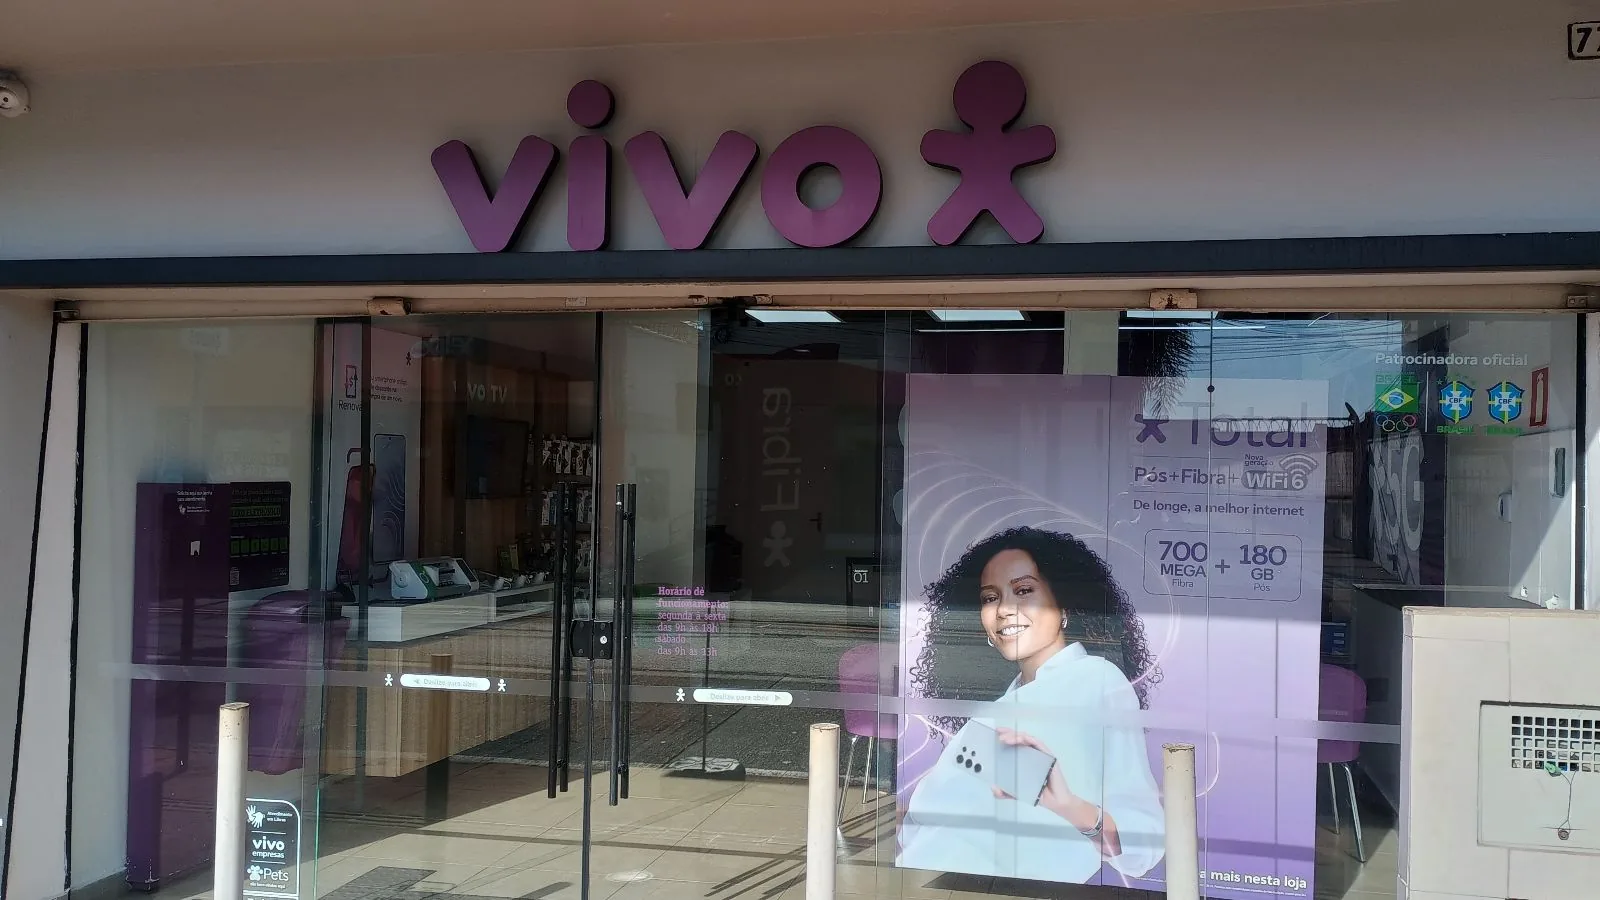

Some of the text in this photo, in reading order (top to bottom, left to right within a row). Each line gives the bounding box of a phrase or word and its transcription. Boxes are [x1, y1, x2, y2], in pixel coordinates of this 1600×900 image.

[1576, 27, 1600, 53] 7
[431, 80, 883, 253] vivo
[1375, 352, 1528, 366] Patrocinadora oficial
[1448, 396, 1463, 404] CBF
[1498, 397, 1512, 405] CBF
[1178, 402, 1308, 448] Total
[1244, 453, 1264, 461] Nova
[1246, 471, 1305, 490] WiFi 6
[1133, 500, 1305, 516] De longe, a melhor internet
[1159, 541, 1208, 563] 700
[1239, 544, 1288, 566] 180
[1160, 563, 1207, 578] MEGA
[1251, 567, 1274, 581] GB
[1172, 578, 1194, 588] Fibra
[1253, 582, 1271, 592] Pós
[658, 586, 692, 596] Horário
[658, 598, 729, 609] funcionamento:
[658, 611, 693, 622] segunda
[704, 612, 727, 621] sexta
[657, 622, 672, 632] das
[675, 623, 686, 632] 9h
[702, 624, 718, 633] 18h
[657, 645, 672, 655] das
[674, 646, 686, 656] 9h
[701, 647, 718, 657] 13h
[252, 836, 285, 851] vivo
[252, 851, 285, 859] empresas
[263, 868, 289, 881] Pets
[1210, 871, 1241, 882] mais
[1244, 874, 1281, 887] nesta
[1284, 875, 1307, 890] loja
